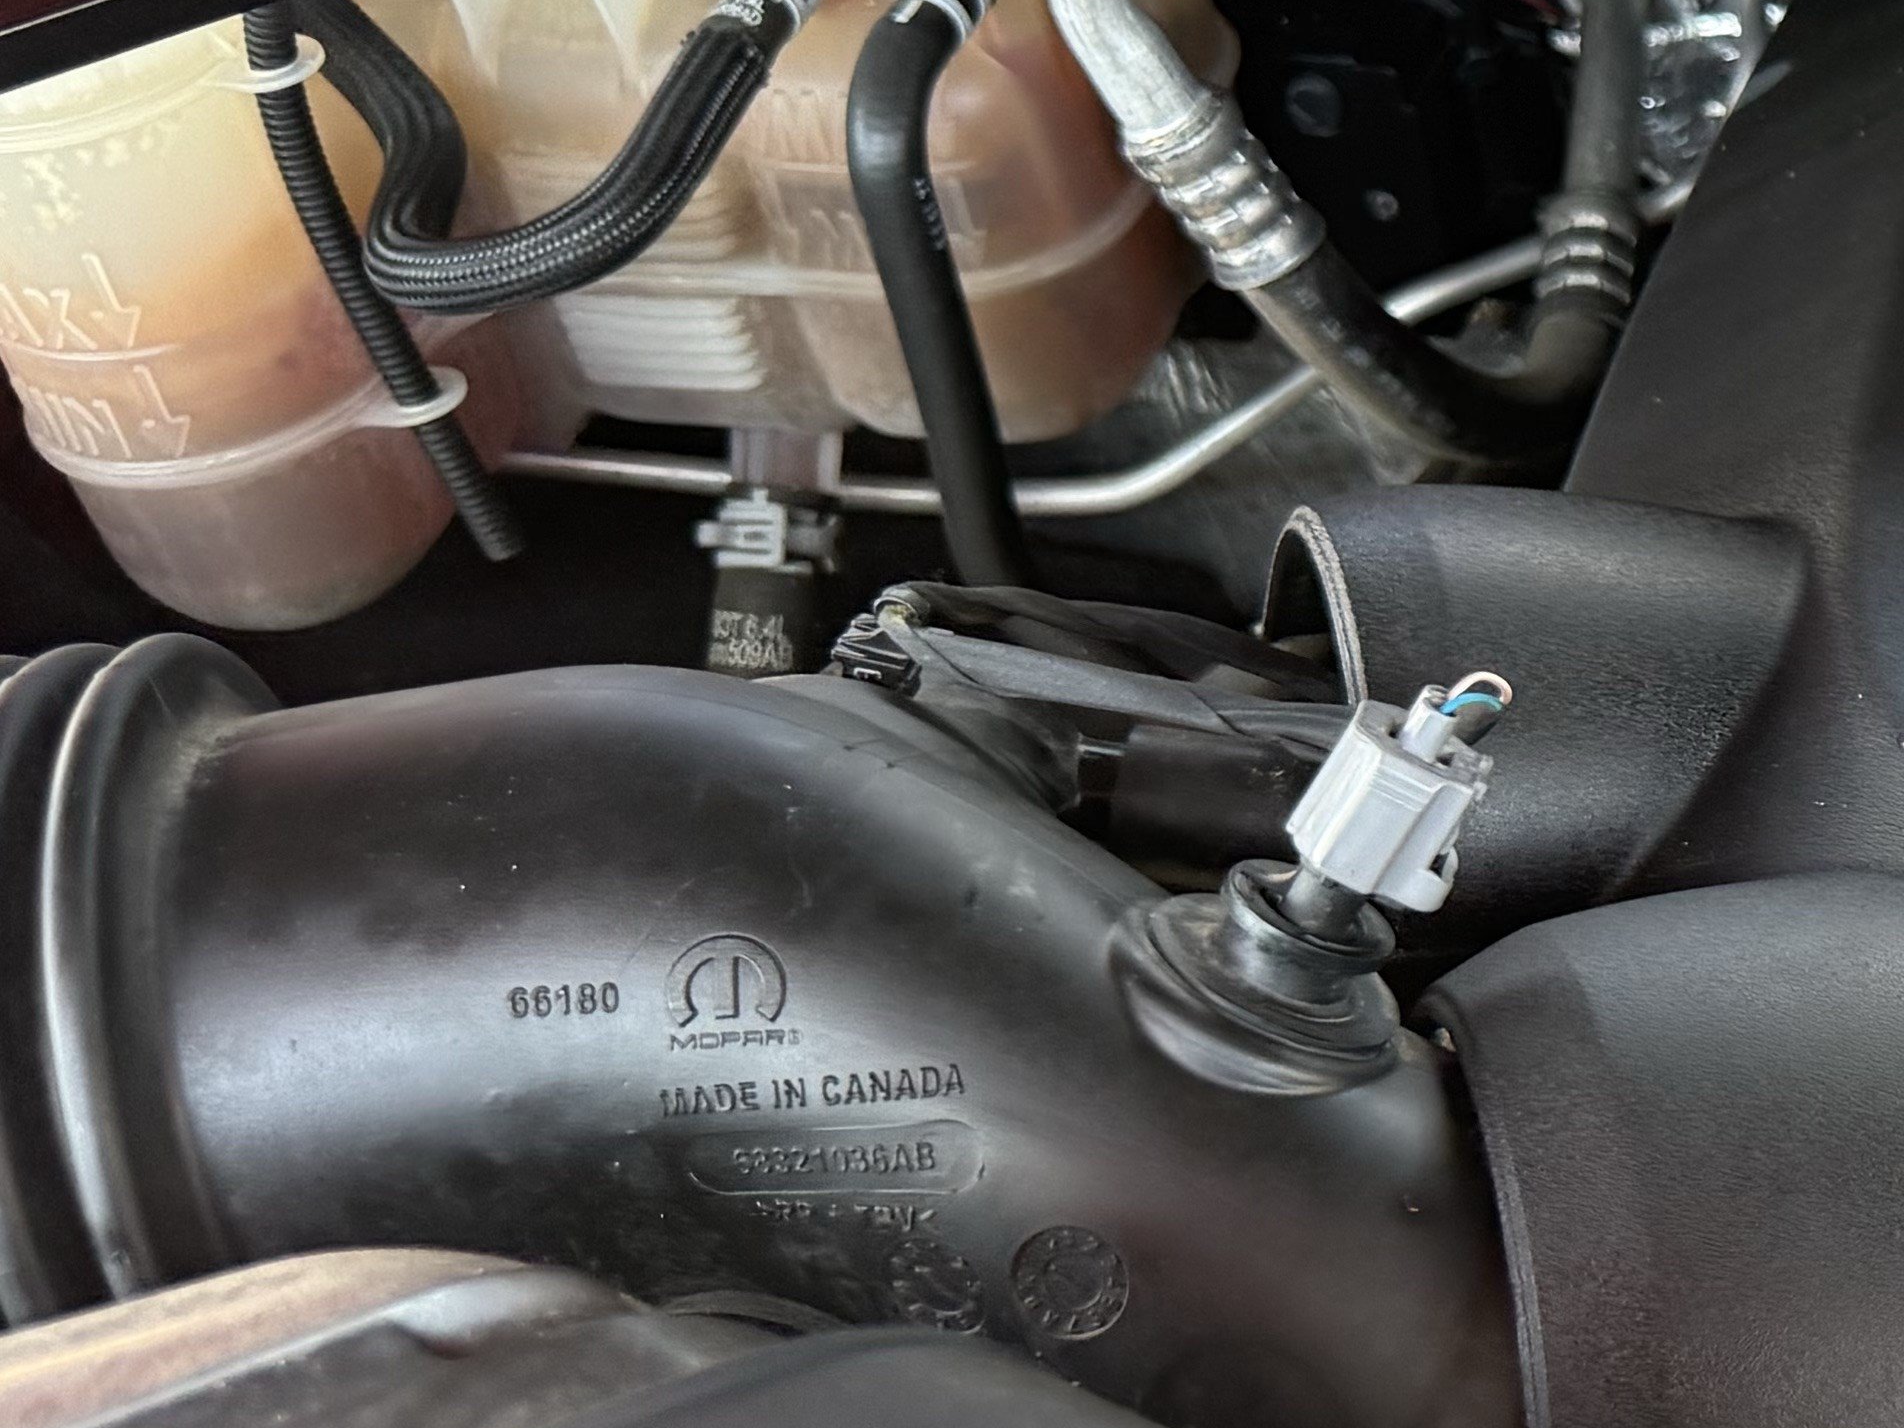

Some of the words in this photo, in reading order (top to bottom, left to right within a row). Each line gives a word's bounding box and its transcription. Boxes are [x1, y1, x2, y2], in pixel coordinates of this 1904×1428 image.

[508, 981, 620, 1019] 66180
[659, 1081, 761, 1118] MADE
[770, 1077, 807, 1110] IN
[821, 1063, 966, 1107] CANADA
